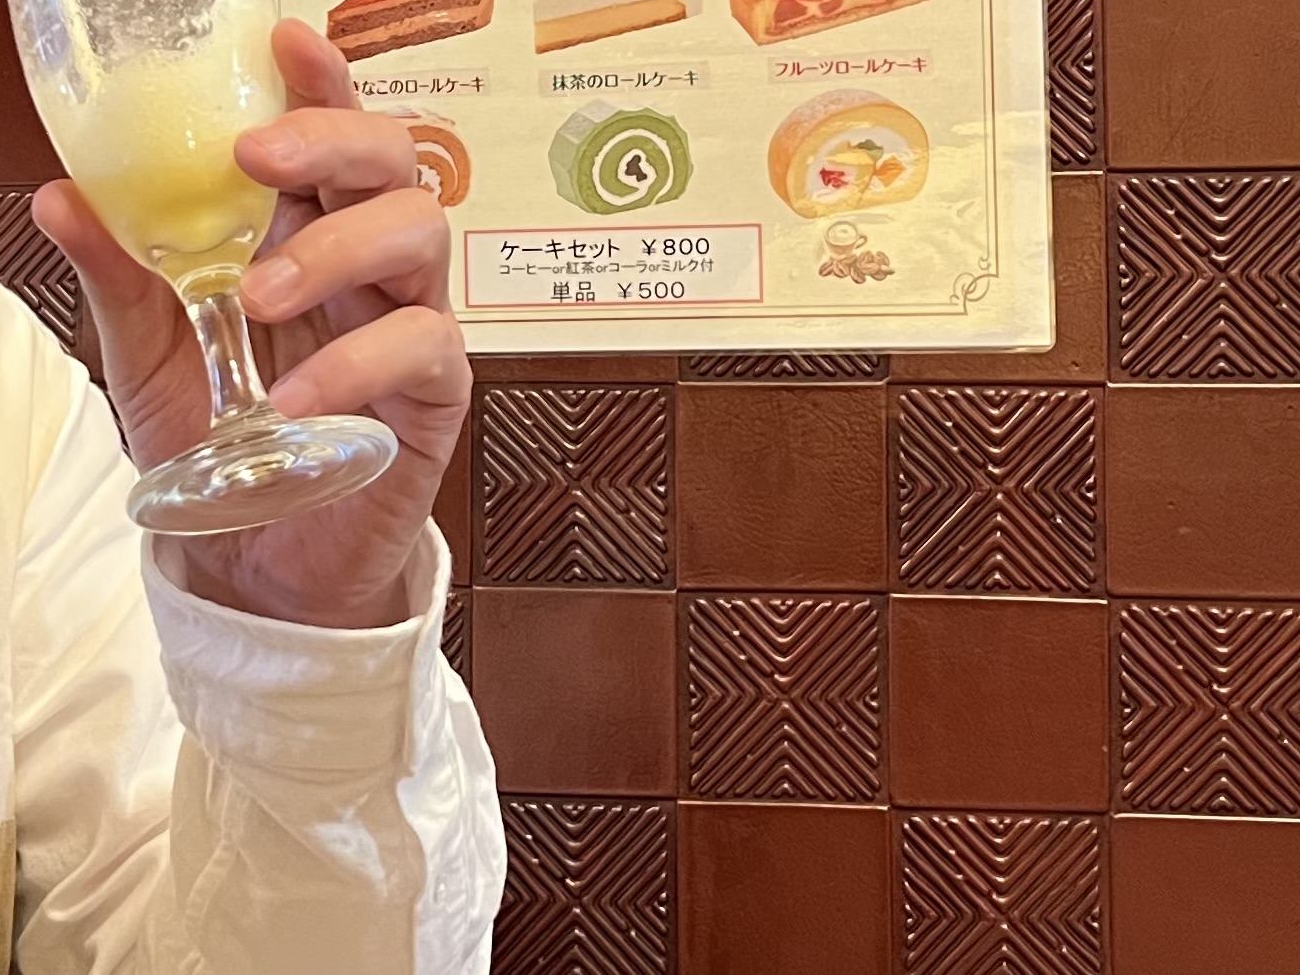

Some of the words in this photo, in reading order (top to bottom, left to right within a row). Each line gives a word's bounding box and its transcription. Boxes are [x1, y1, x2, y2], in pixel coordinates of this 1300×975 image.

[775, 57, 927, 77] フルーツロールケーキ
[552, 70, 698, 91] 抹茶のロールケーキ
[500, 238, 620, 261] ケーキセット
[642, 237, 710, 256] ¥800
[551, 281, 595, 303] 単品
[618, 281, 685, 299] ¥500
